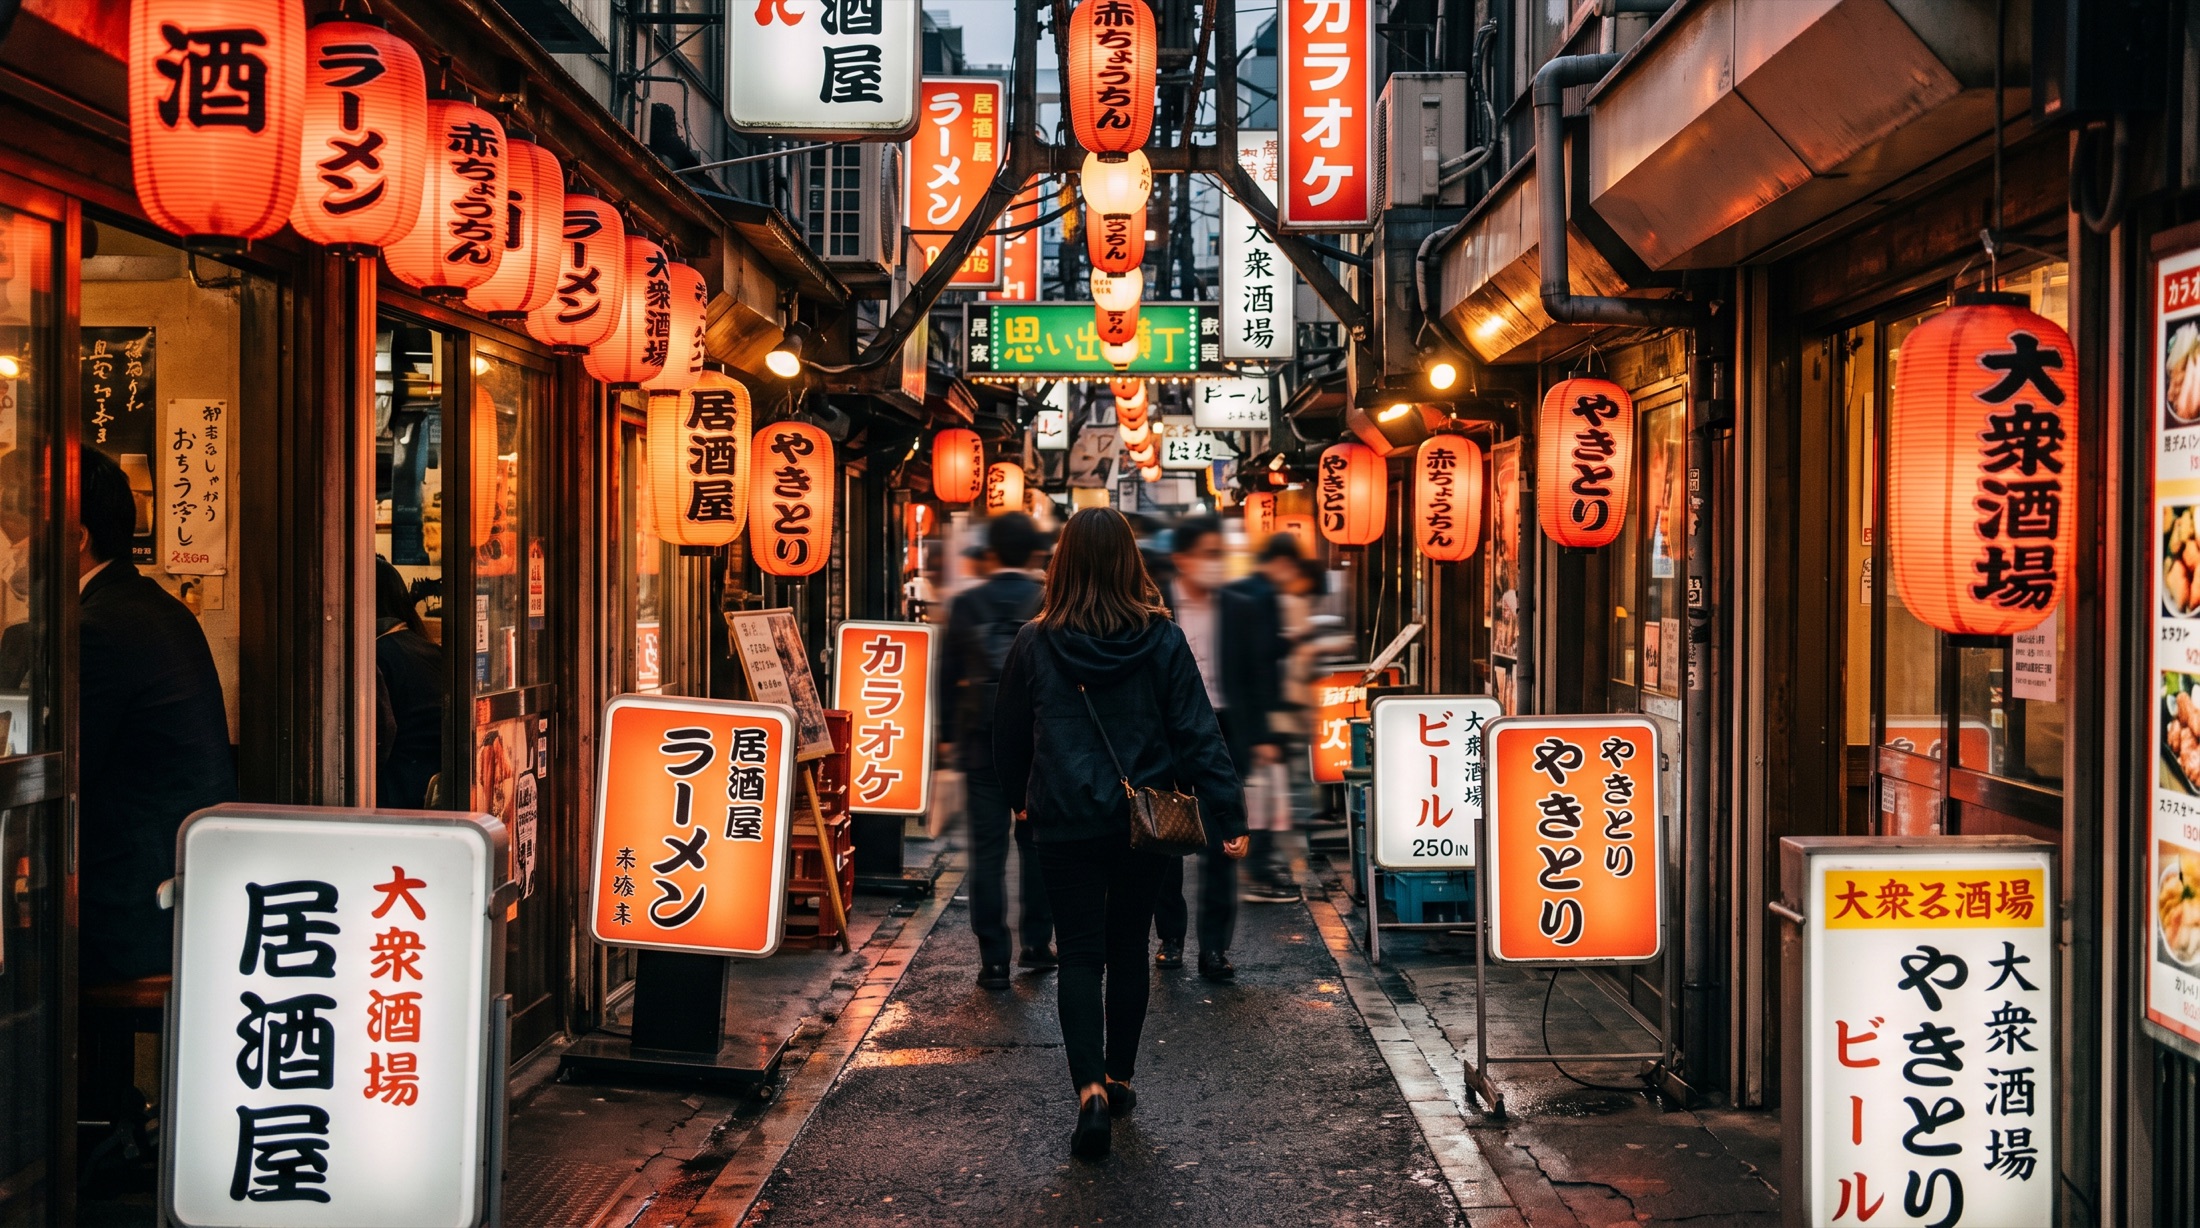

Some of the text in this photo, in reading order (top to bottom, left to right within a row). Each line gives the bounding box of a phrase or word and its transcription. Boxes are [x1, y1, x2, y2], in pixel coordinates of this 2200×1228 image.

[156, 24, 267, 133] 酒
[320, 45, 386, 214] ラーメン
[971, 94, 992, 162] 居酒屋
[1094, 1, 1136, 129] 赤ちょうちん
[1302, 0, 1354, 206] カラオケ
[447, 123, 499, 263] 赤ちょうちん
[926, 93, 962, 225] ラーメン
[558, 210, 602, 323] ラーメン
[641, 251, 671, 368] 大衆酒場
[1243, 224, 1275, 348] 大衆酒場
[686, 389, 737, 522] 居酒屋
[771, 432, 814, 568] やきとり
[1322, 455, 1348, 531] やきとり
[1426, 448, 1456, 547] 赤ちょうちん
[1571, 394, 1620, 531] やきとり
[1973, 330, 2066, 610] 大衆酒場
[726, 728, 768, 841] 居酒屋
[855, 636, 905, 803] カラオケ
[1417, 711, 1453, 828] ビール
[650, 727, 716, 928] ラーメン
[1533, 738, 1584, 946] やきとり
[1602, 738, 1634, 877] やきとり
[229, 880, 341, 1203] 居酒屋
[363, 865, 427, 1106] 大衆酒場
[1832, 1016, 1884, 1222] ビール
[1898, 945, 1968, 1228] やきとり
[1984, 941, 2040, 1182] 大衆酒場
